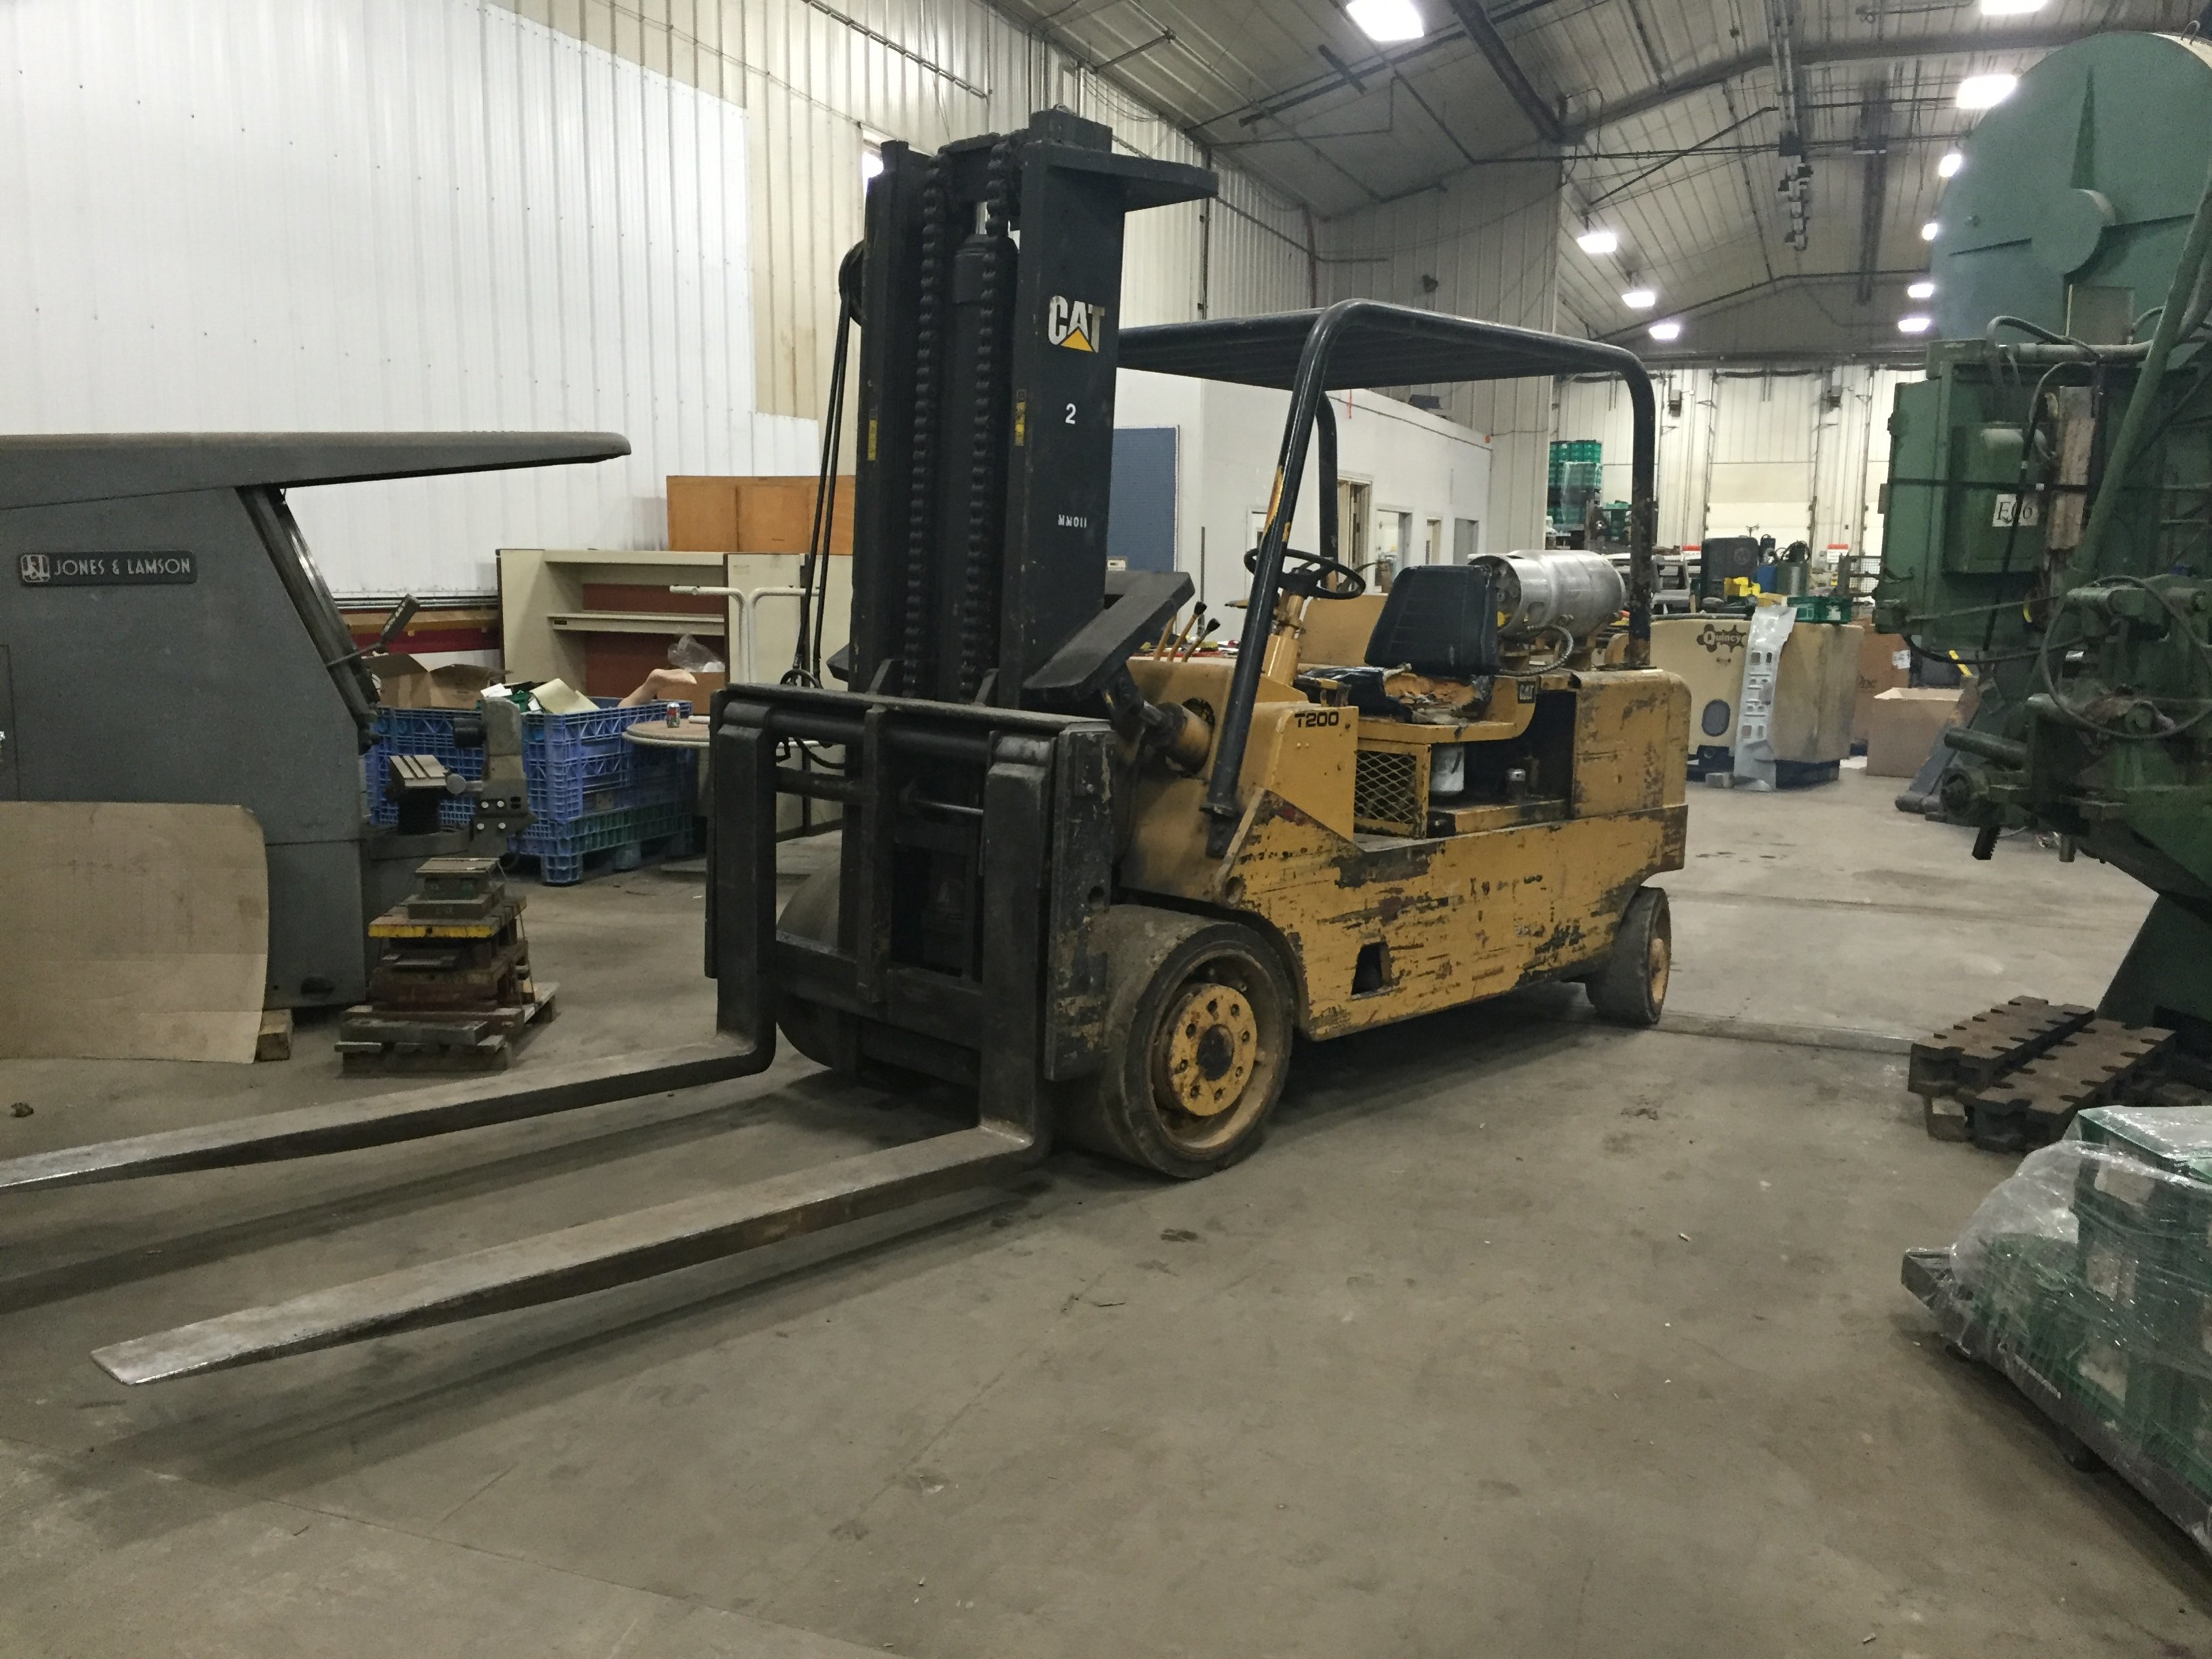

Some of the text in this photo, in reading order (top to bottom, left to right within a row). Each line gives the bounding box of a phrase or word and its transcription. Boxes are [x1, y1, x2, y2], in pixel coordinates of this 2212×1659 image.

[1048, 295, 1105, 353] CAT
[1065, 403, 1077, 425] 2
[54, 559, 104, 576] JONES
[127, 557, 190, 575] LAMSON
[1703, 631, 1742, 645] Quincy
[1294, 711, 1340, 728] T200
